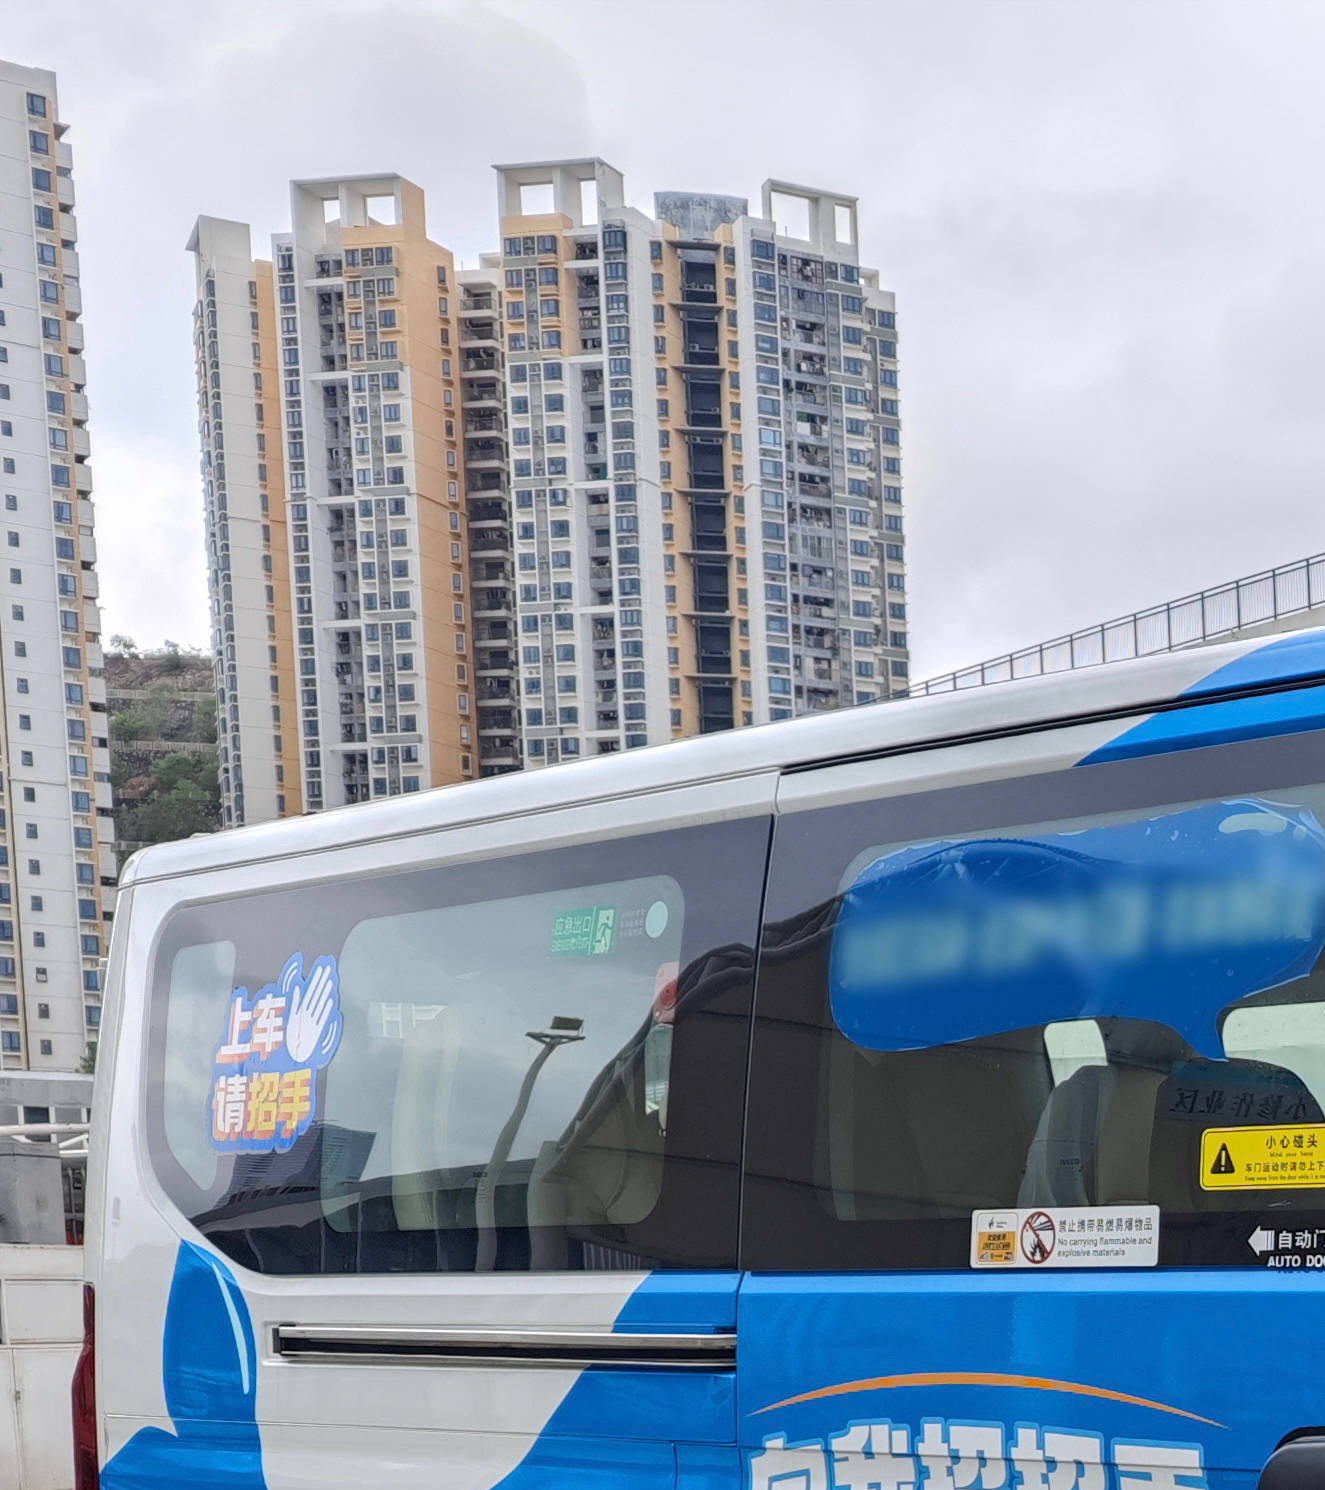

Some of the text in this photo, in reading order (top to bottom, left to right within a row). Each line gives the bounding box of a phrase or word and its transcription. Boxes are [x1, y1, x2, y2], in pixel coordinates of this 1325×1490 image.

[218, 993, 286, 1060] 上车
[214, 1069, 311, 1138] 请招手
[1266, 1134, 1318, 1149] 小心碰头
[1059, 1217, 1153, 1233] 禁止携带易燃易爆物品
[1058, 1237, 1068, 1246] No
[1069, 1237, 1098, 1248] carrying
[1138, 1236, 1152, 1245] and
[1058, 1248, 1126, 1257] explosive materials
[1267, 1255, 1301, 1267] AUTO
